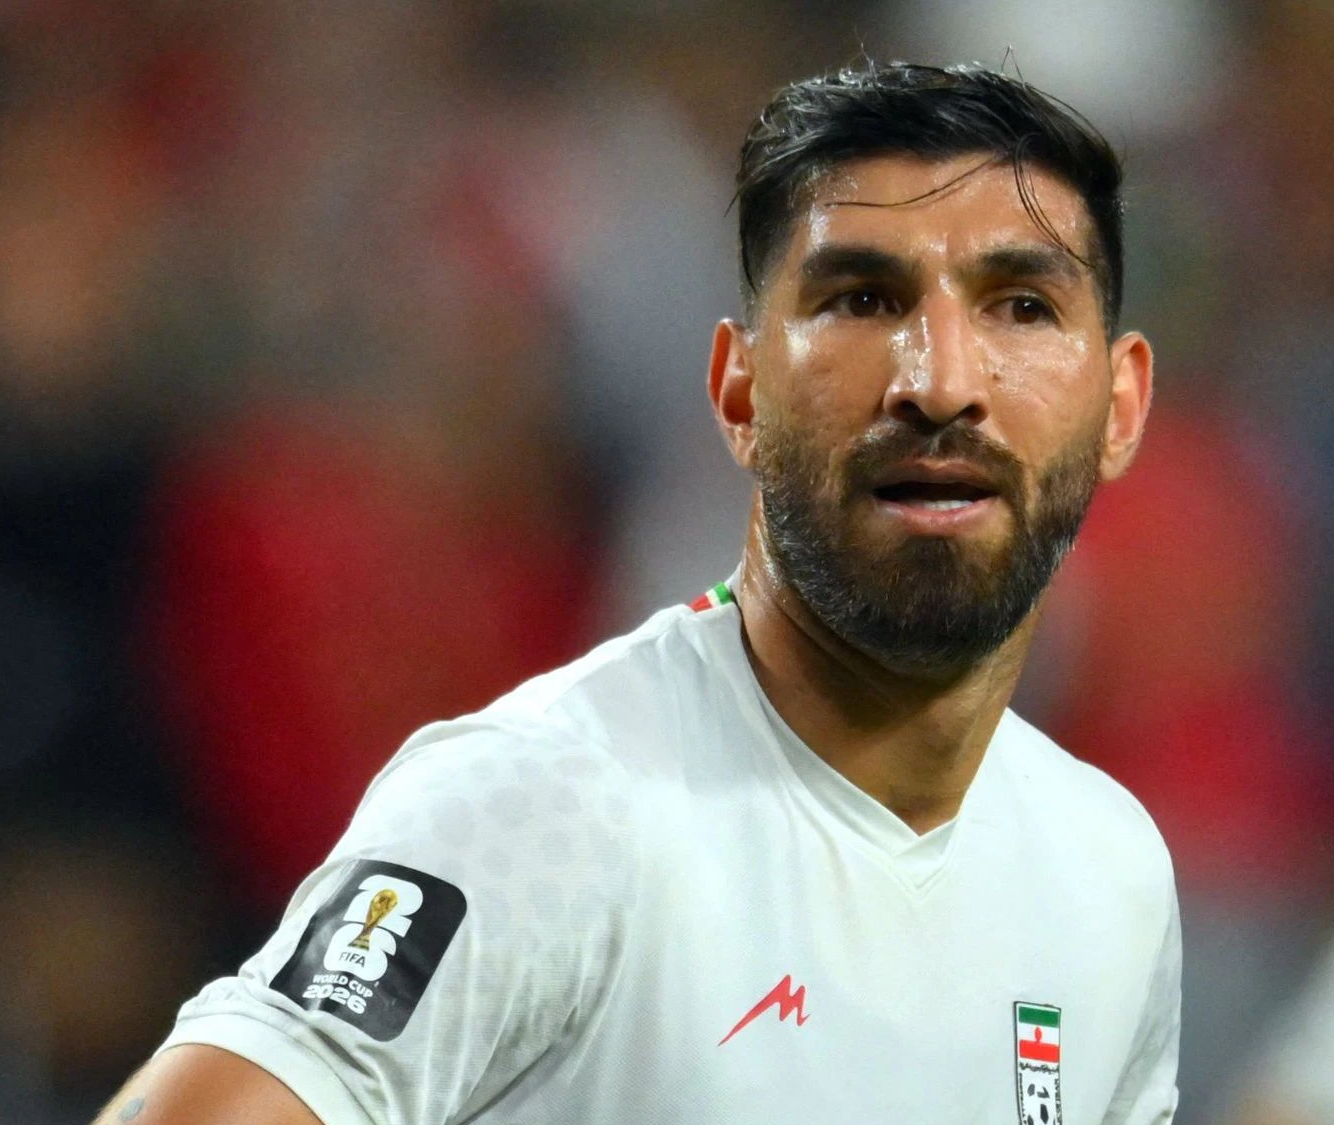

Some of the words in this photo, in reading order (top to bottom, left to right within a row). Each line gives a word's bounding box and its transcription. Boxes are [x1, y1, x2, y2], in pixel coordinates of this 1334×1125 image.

[339, 952, 366, 968] FIFA
[313, 974, 348, 987] WORLD
[348, 980, 373, 998] CUP
[302, 984, 367, 1014] 2026
